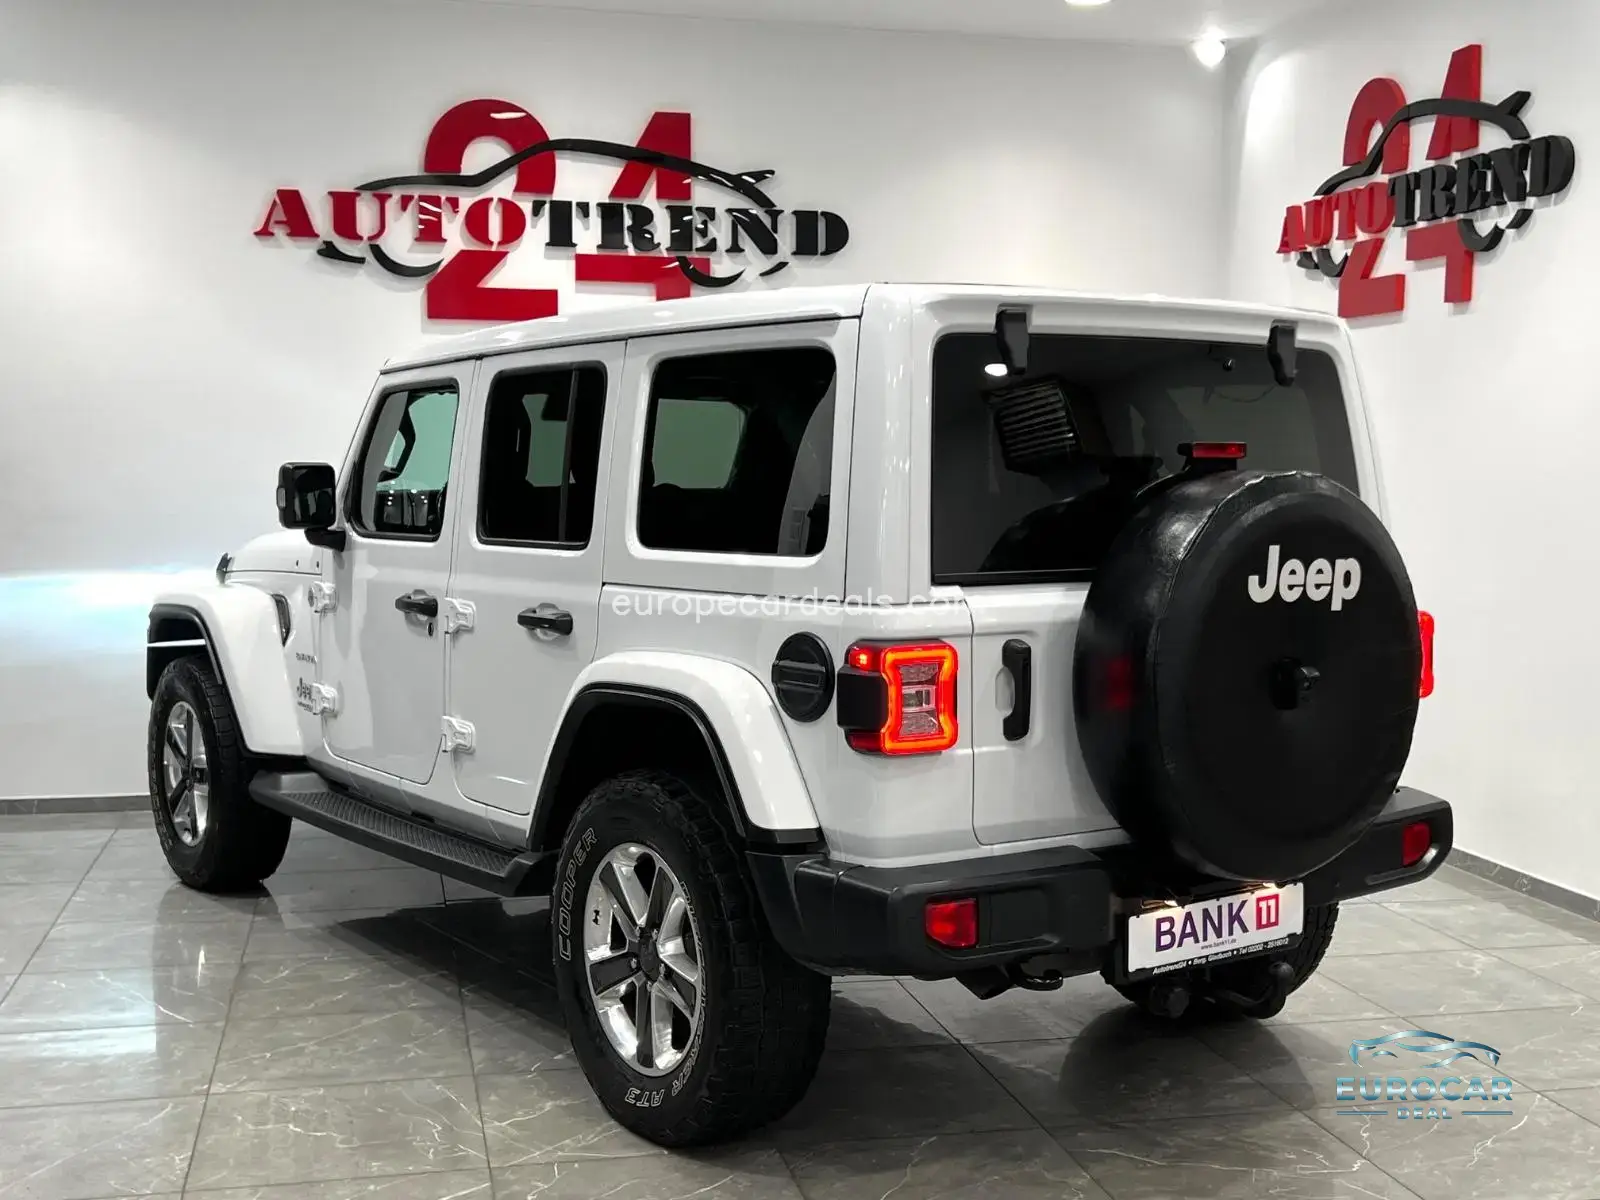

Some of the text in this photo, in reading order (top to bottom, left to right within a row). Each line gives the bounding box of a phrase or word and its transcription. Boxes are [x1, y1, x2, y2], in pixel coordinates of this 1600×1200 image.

[424, 98, 711, 321] 24
[1338, 44, 1483, 318] 24
[1247, 544, 1362, 612] Jeep
[558, 827, 598, 961] COOPER
[1155, 897, 1278, 953] BANK 11
[624, 1087, 665, 1108] AT3
